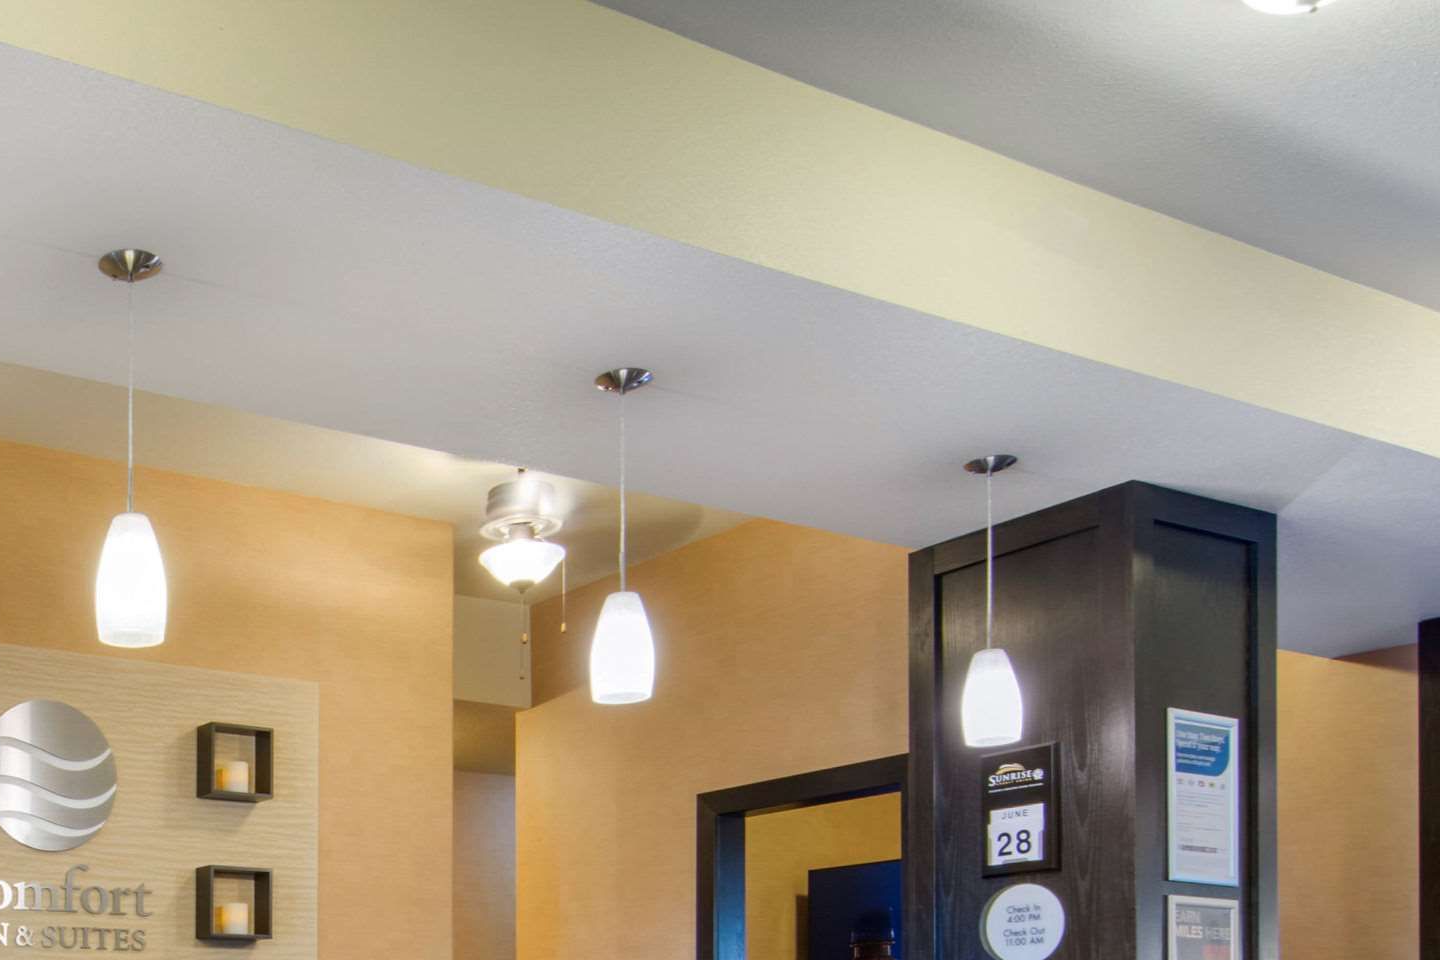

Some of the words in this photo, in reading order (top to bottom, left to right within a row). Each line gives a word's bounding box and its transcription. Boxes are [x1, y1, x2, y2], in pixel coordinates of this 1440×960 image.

[988, 769, 1033, 787] SUNRISE
[1001, 809, 1029, 820] JUNE
[997, 829, 1031, 857] 28
[1007, 904, 1030, 914] Check
[1028, 913, 1041, 921] PM
[15, 925, 34, 947] &
[41, 925, 146, 951] SUITES
[1003, 928, 1027, 938] Check
[1030, 936, 1045, 945] AM
